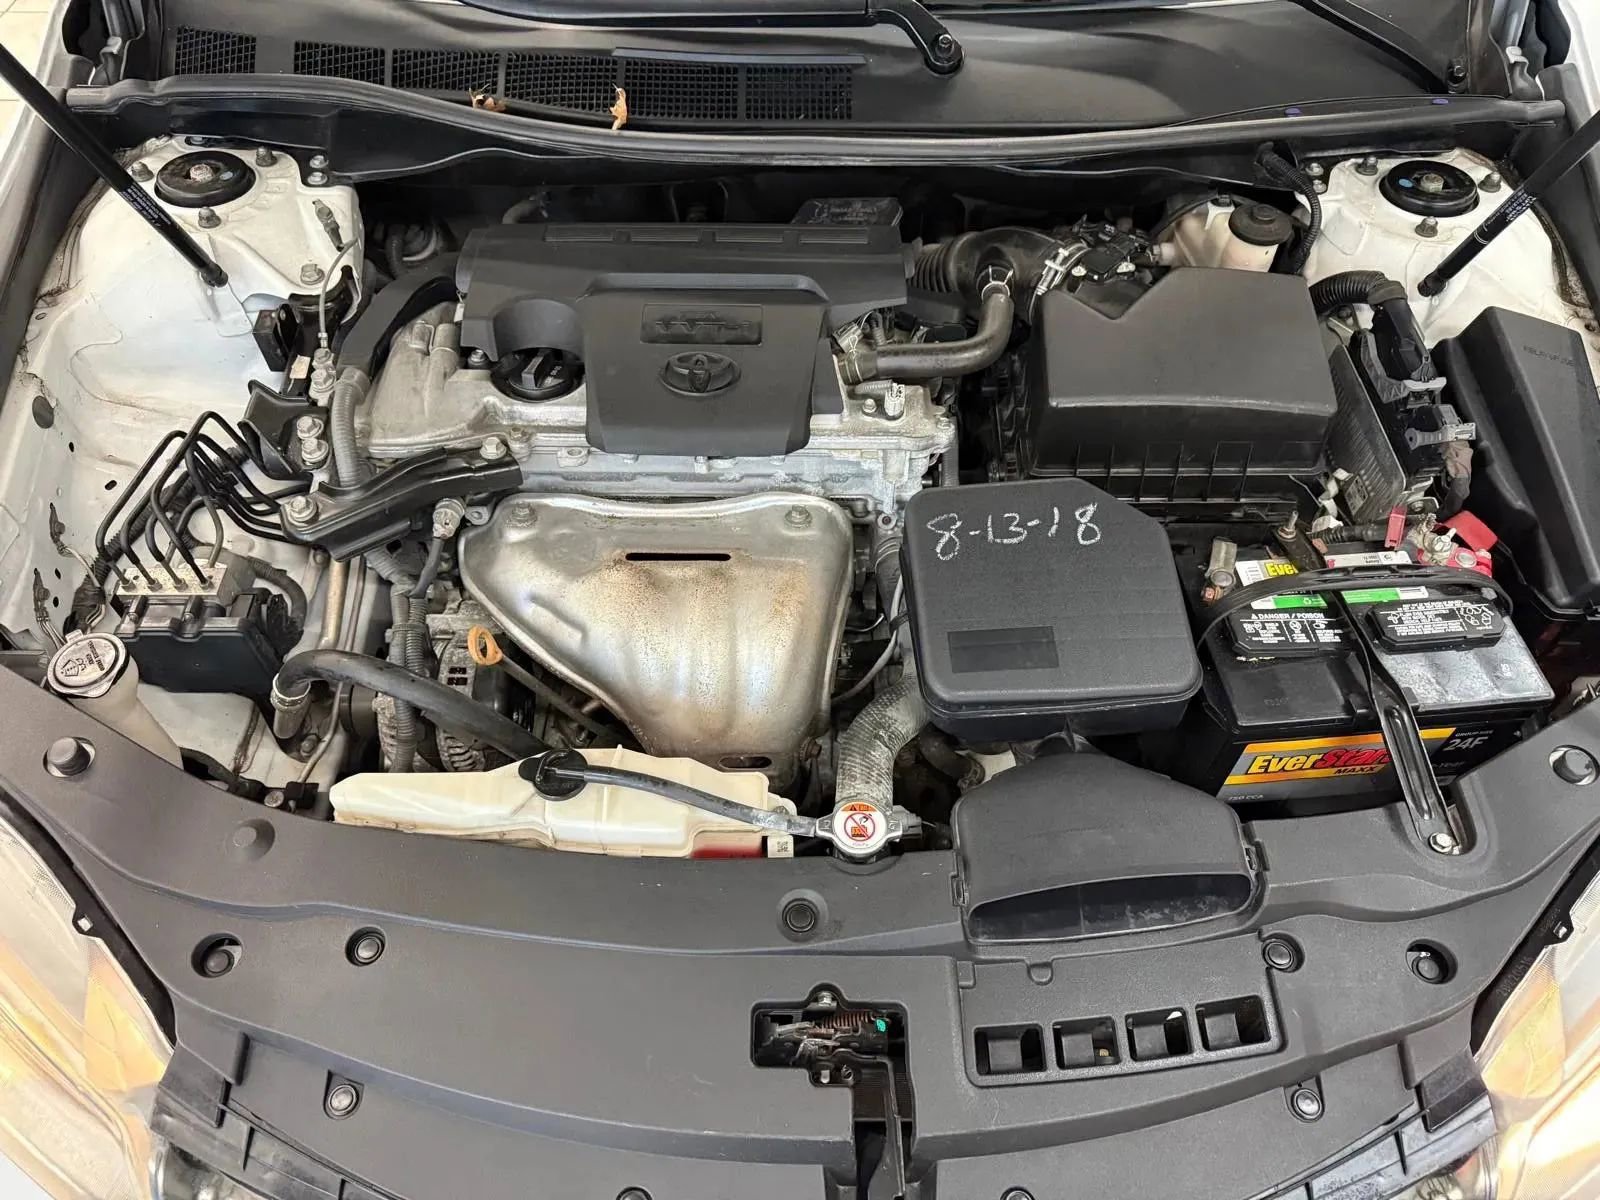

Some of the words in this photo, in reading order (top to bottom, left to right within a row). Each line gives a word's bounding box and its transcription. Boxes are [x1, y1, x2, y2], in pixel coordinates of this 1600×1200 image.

[926, 503, 1101, 561] 8-13-18
[1442, 736, 1489, 752] 24F
[1334, 766, 1377, 775] MAXX
